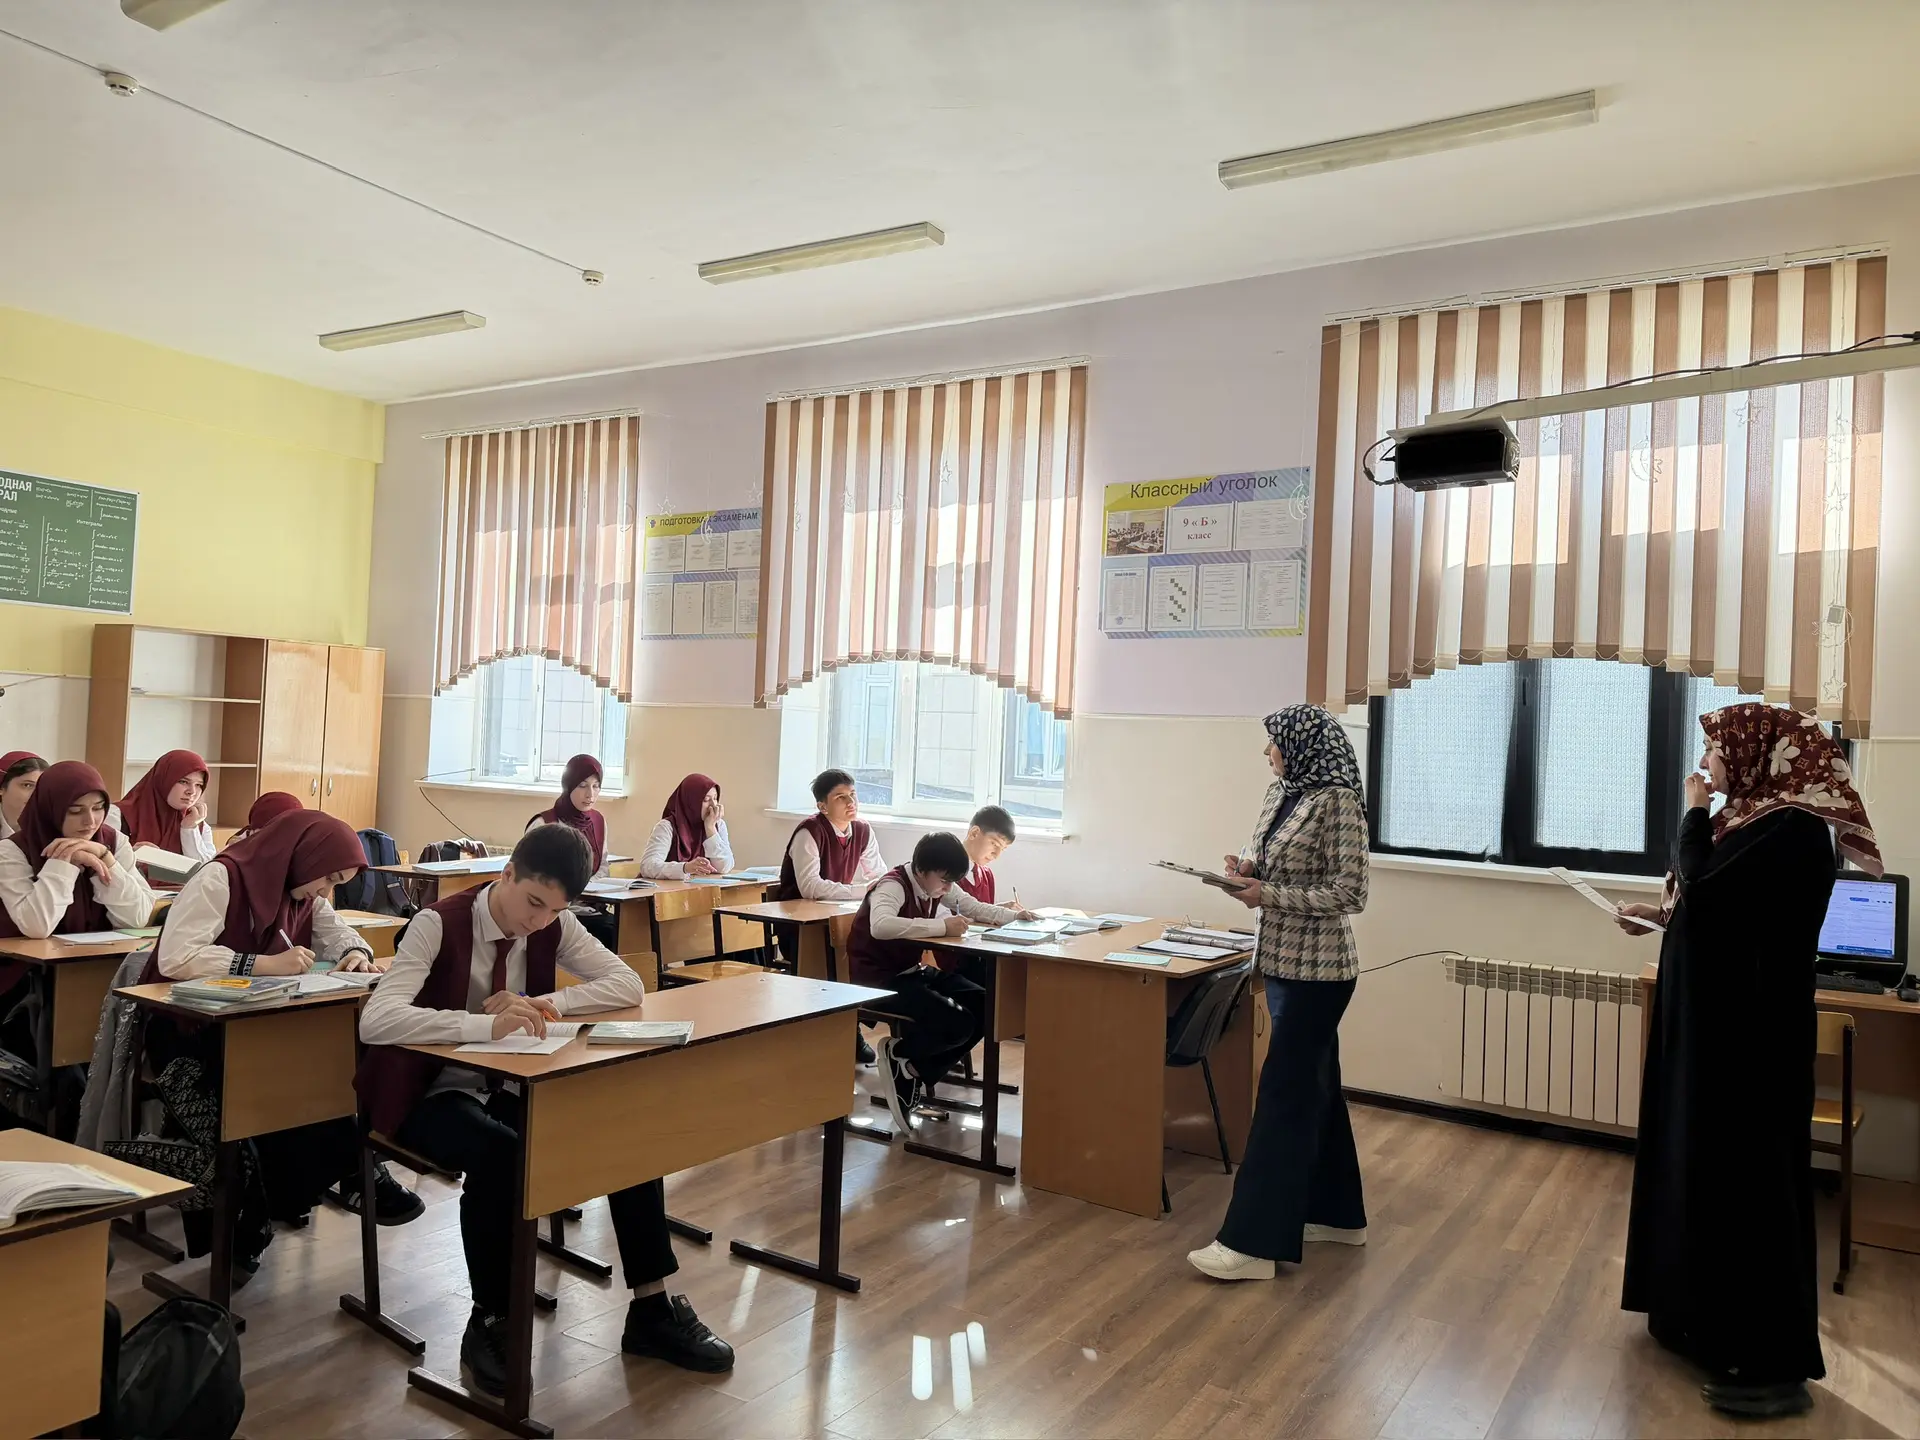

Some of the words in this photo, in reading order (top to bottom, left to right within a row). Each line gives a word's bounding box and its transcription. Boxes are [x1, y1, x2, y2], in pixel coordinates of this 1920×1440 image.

[1130, 478, 1213, 499] Классный
[1219, 475, 1278, 495] уголок
[713, 512, 758, 522] ЭКЗАМЕНАМ
[1183, 518, 1189, 527] 9
[1187, 531, 1212, 541] класс
